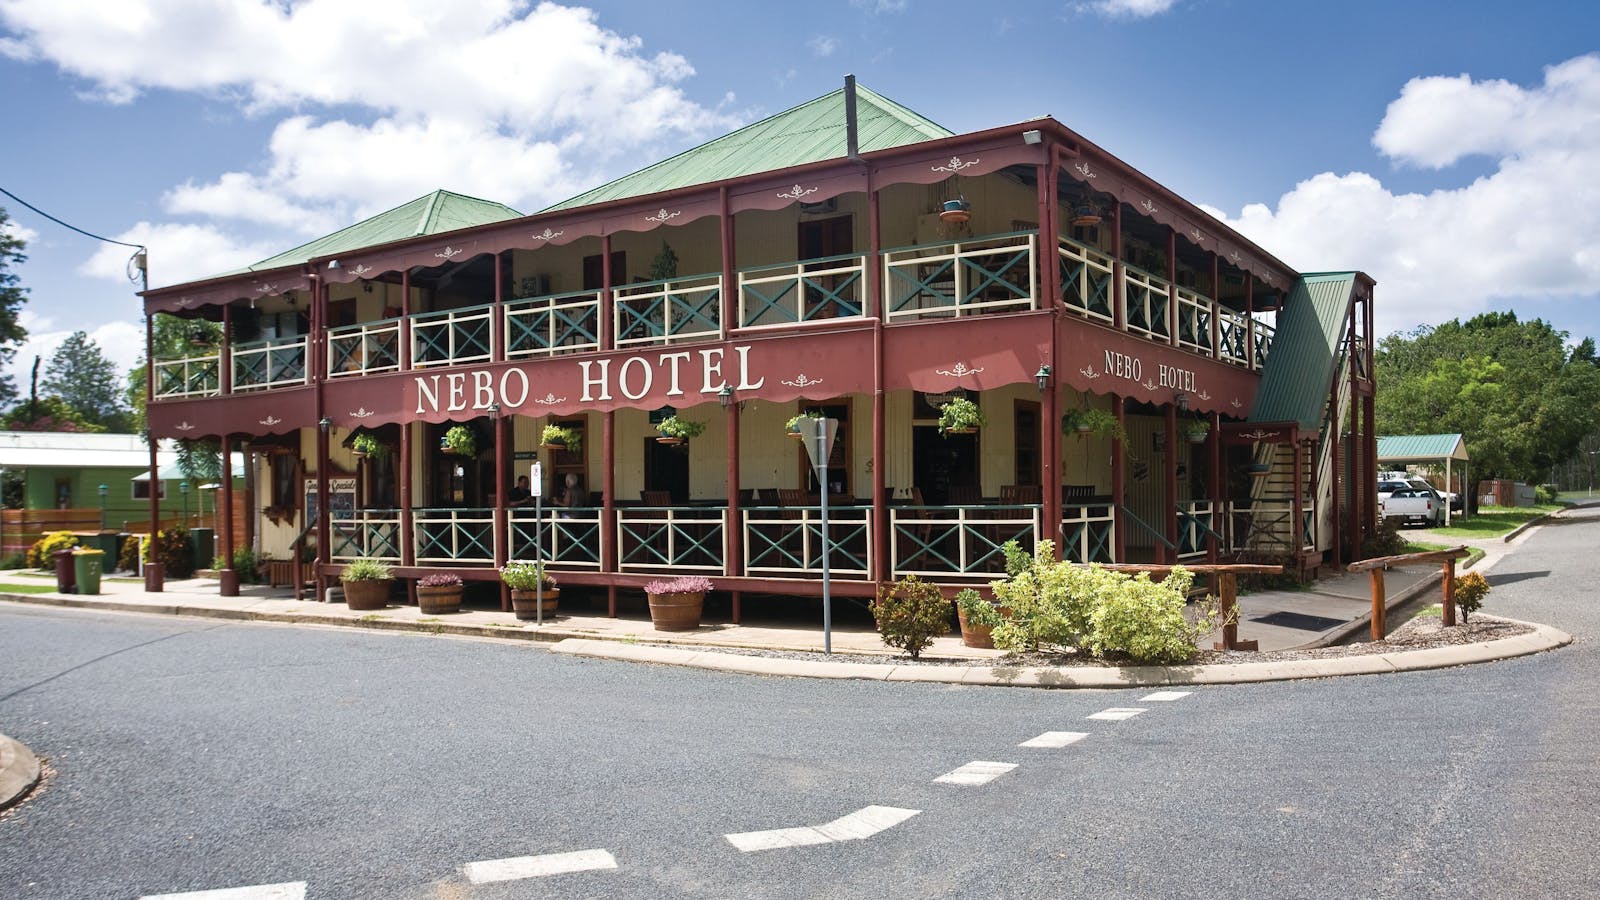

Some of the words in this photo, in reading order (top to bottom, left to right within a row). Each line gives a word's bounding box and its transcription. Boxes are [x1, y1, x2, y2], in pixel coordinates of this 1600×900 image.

[414, 367, 530, 414] NEBO
[577, 346, 765, 402] HOTEL
[1104, 350, 1142, 382] NEBO
[1159, 364, 1197, 393] HOTEL
